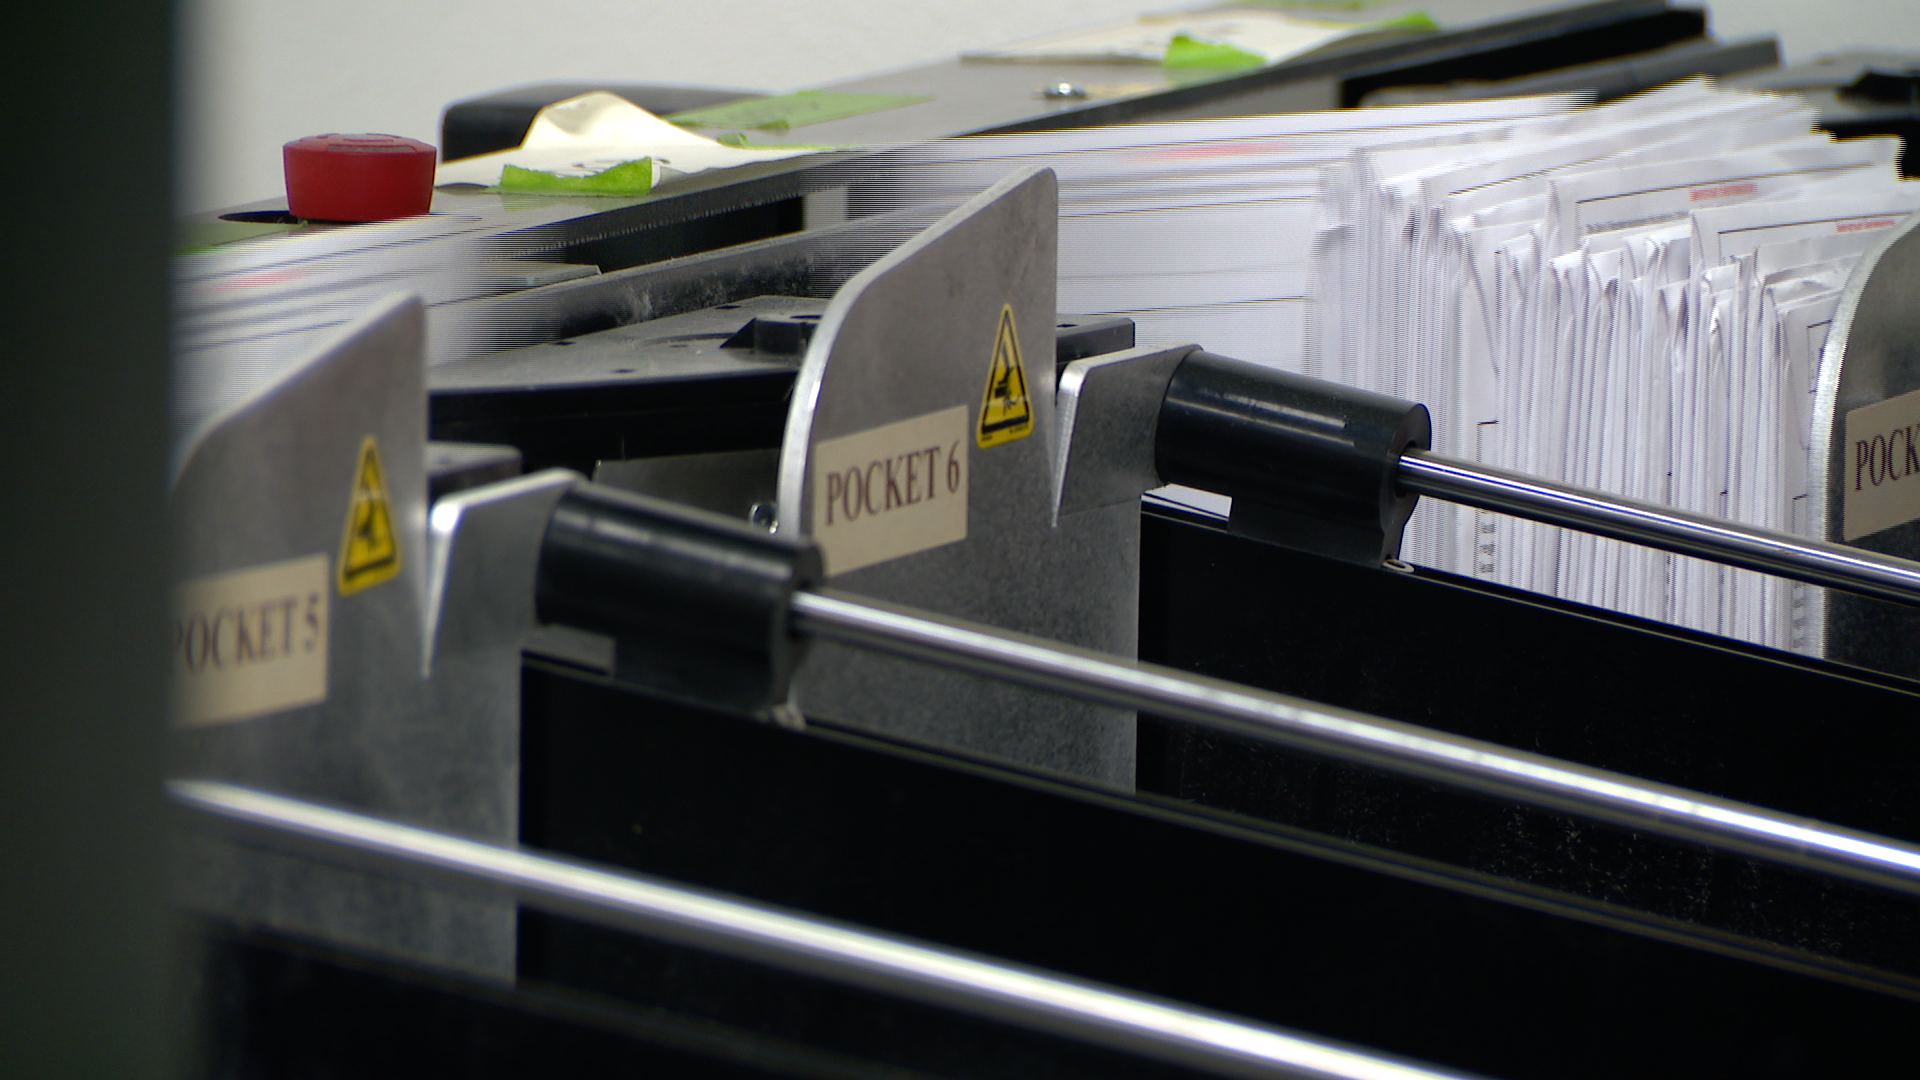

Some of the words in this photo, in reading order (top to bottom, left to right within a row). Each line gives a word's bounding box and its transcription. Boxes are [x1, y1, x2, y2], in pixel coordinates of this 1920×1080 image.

[826, 446, 941, 526] POCKET
[946, 440, 960, 493] 6
[304, 593, 320, 649] 5
